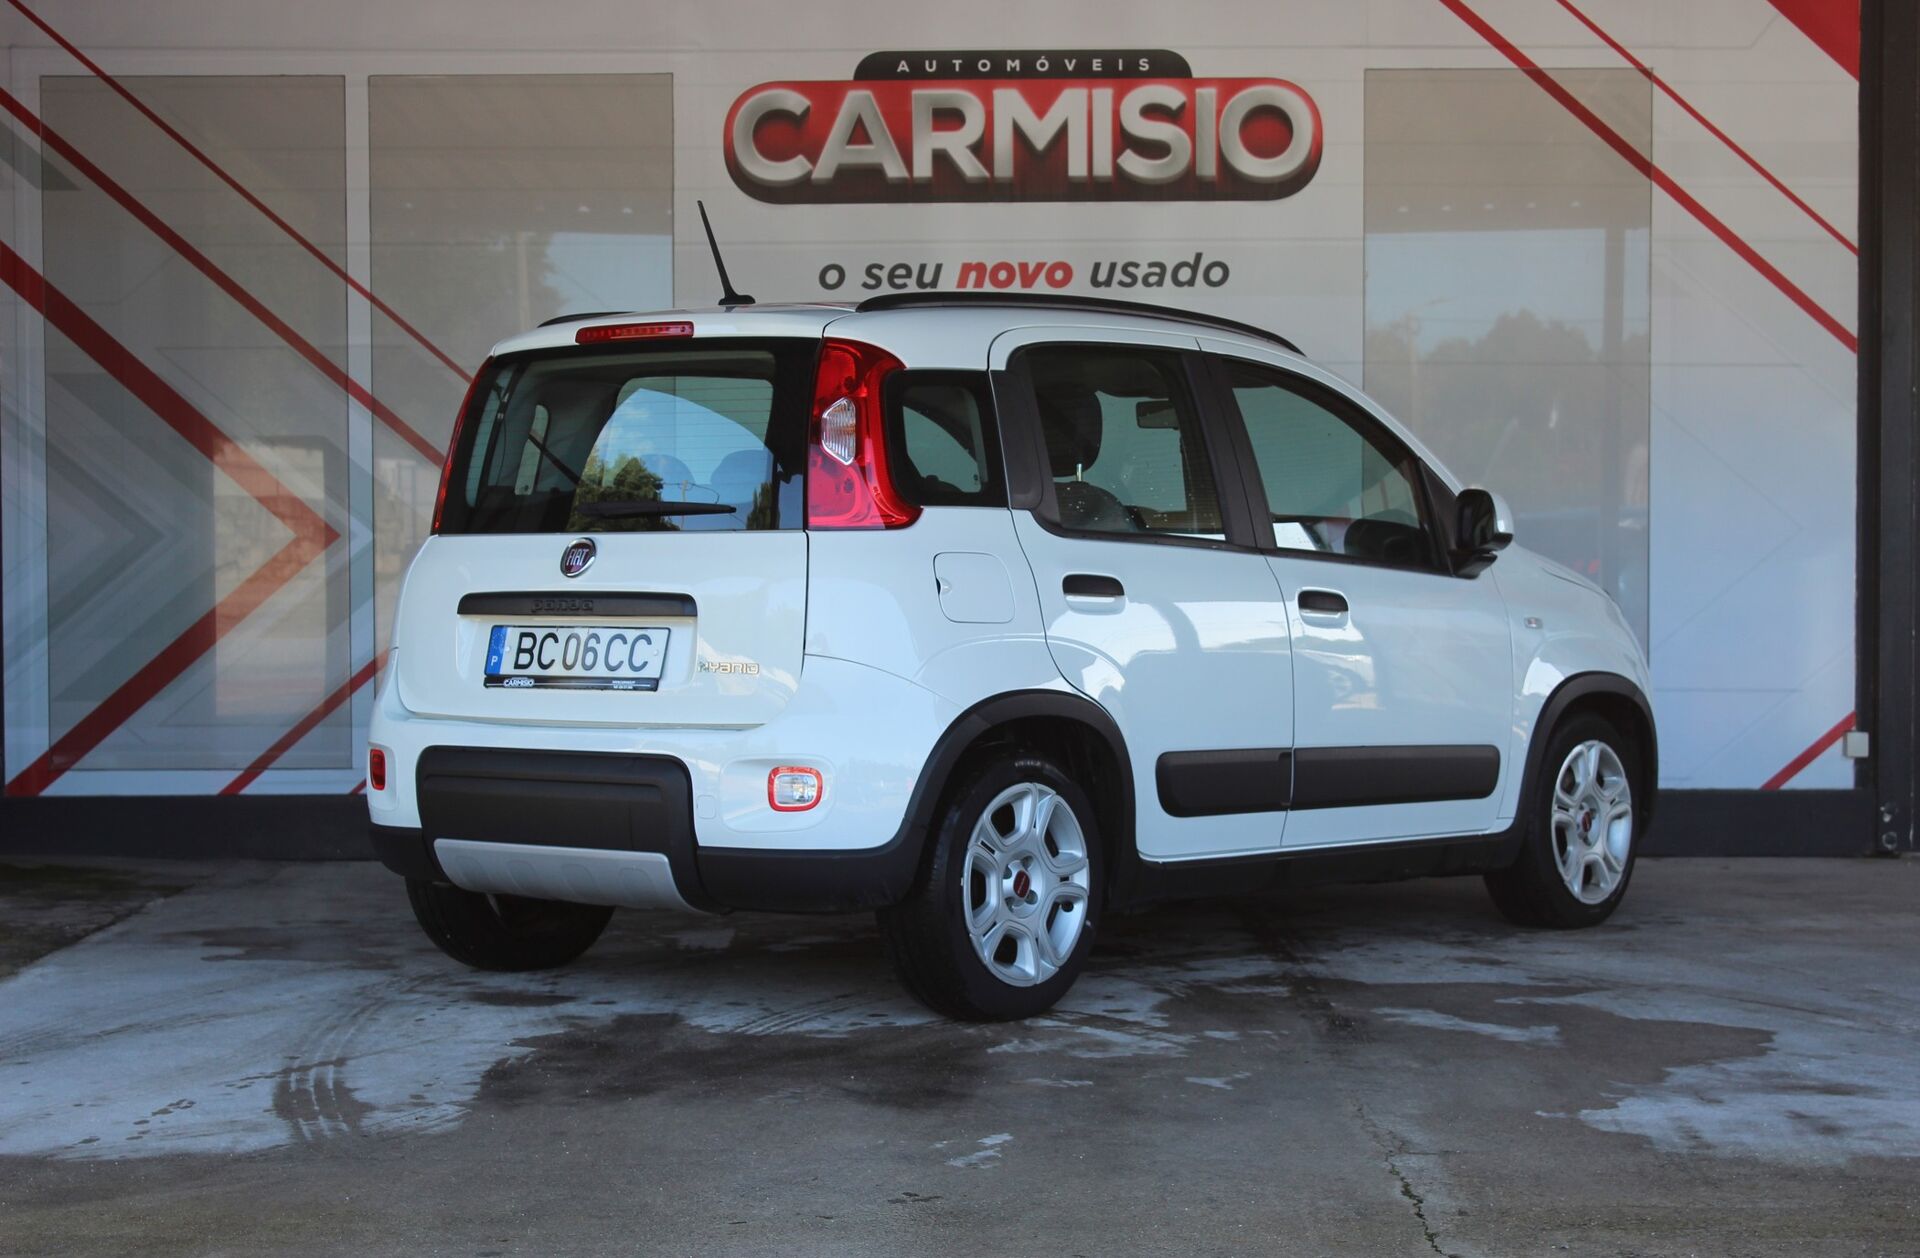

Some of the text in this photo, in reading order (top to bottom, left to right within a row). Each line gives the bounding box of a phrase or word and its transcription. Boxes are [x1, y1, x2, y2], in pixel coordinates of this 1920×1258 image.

[896, 55, 1151, 74] AUTOMÓVEIS
[731, 84, 1315, 184] CARMISIO
[817, 252, 1231, 290] o seu novo usado
[566, 548, 590, 566] FIAT
[490, 655, 498, 666] P
